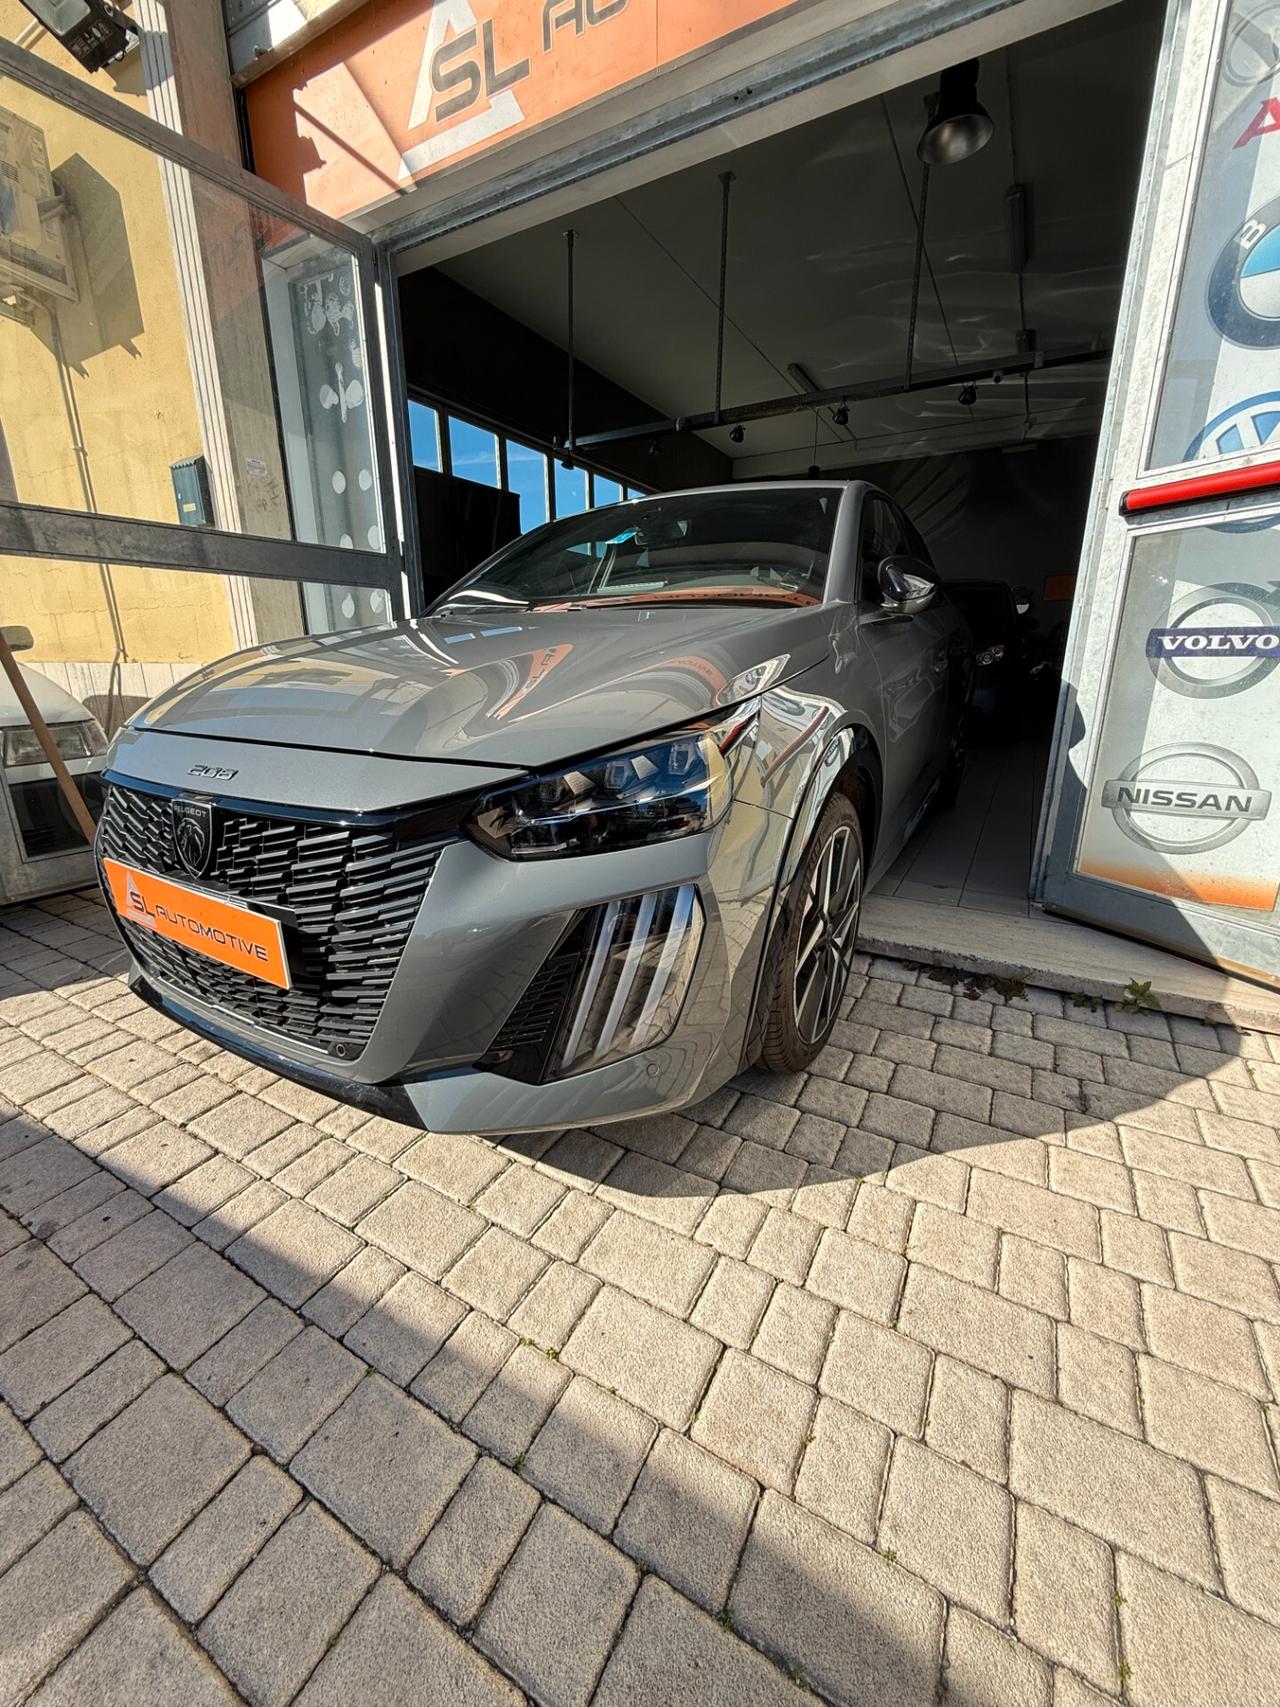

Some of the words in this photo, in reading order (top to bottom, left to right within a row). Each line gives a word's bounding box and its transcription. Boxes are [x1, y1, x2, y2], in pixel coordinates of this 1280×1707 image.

[431, 18, 531, 124] SL
[1158, 634, 1280, 650] VOLVO
[187, 764, 239, 781] 208
[1117, 786, 1253, 813] NISSAN
[173, 805, 208, 818] PEUGEOT
[129, 890, 156, 918] SL
[155, 904, 269, 962] AUTOMOTIVE
